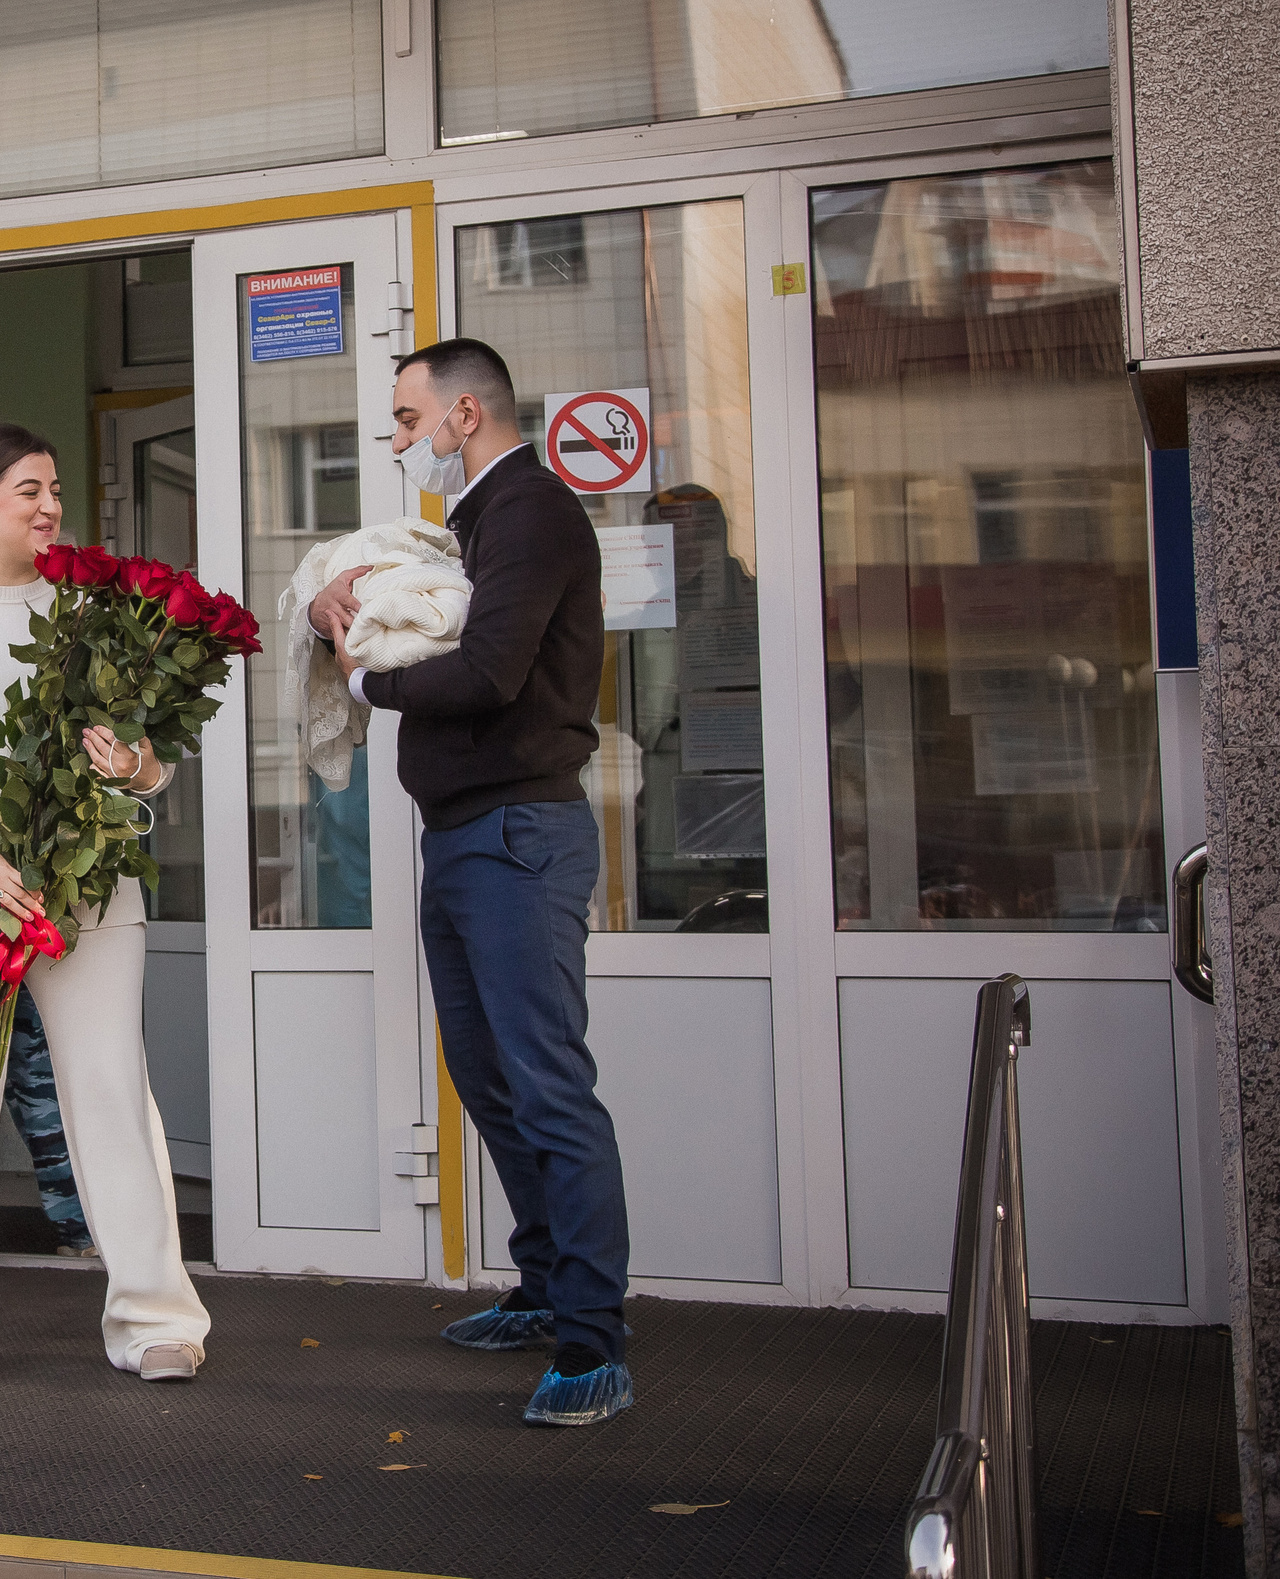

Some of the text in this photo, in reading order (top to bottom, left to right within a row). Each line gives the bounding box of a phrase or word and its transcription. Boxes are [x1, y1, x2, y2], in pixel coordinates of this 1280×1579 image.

[250, 271, 337, 292] ВНИМАНИЕ!
[296, 309, 333, 318] охранные
[256, 322, 303, 332] организации
